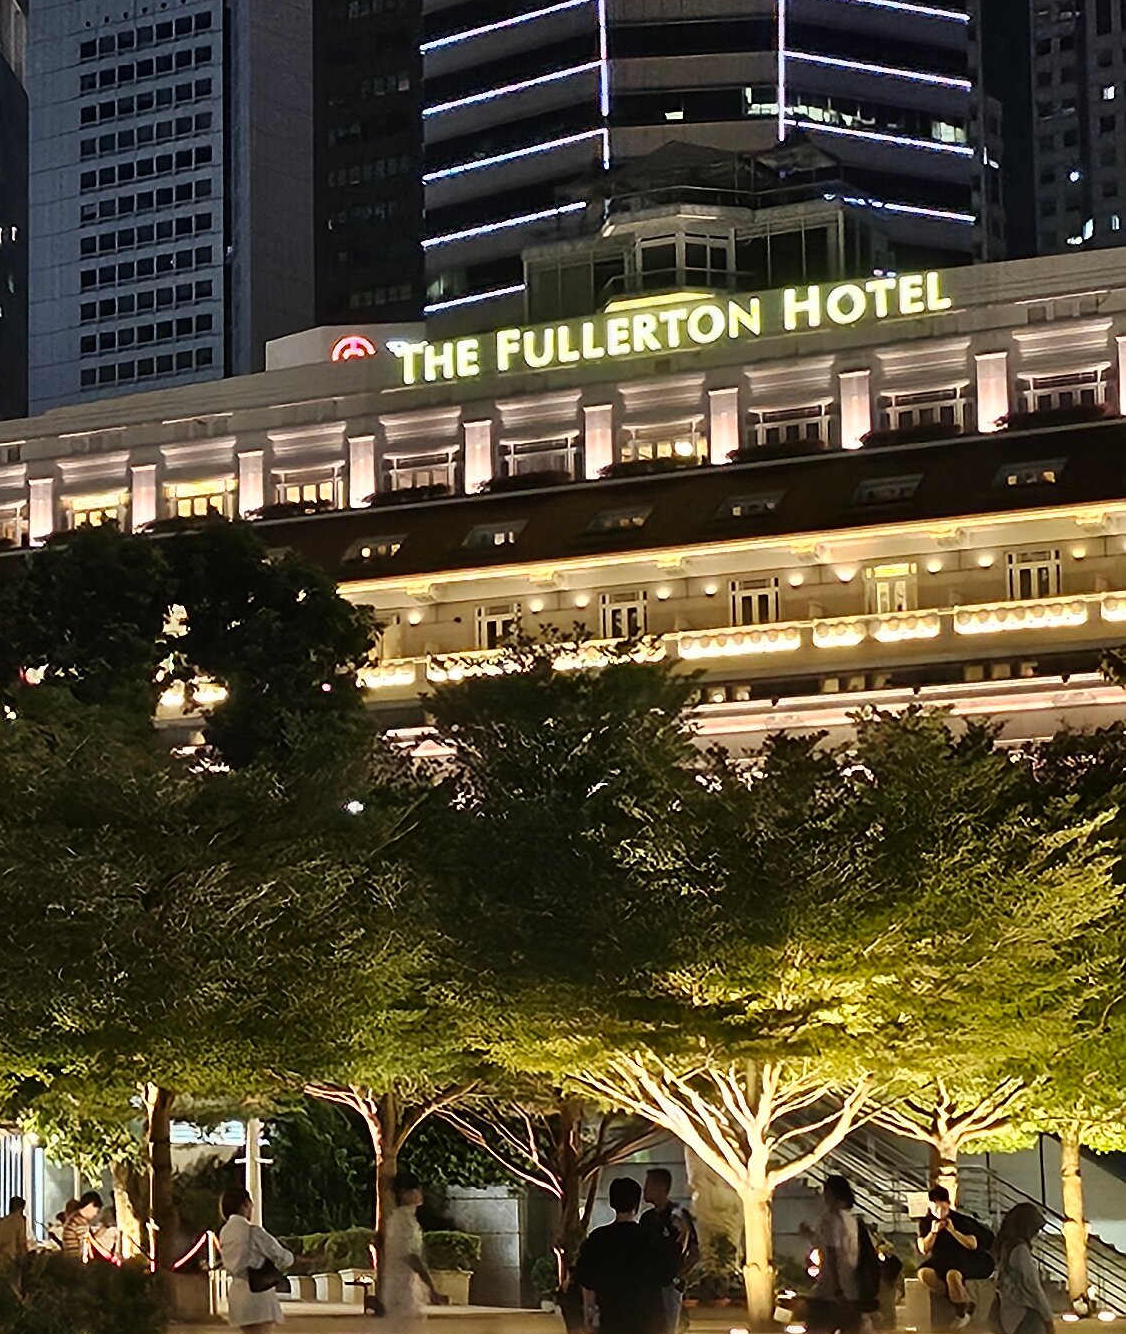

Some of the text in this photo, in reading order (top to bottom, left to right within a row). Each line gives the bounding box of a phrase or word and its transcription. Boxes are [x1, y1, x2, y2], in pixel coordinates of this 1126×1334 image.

[397, 271, 952, 385] THE FULLERTON HOTEL
